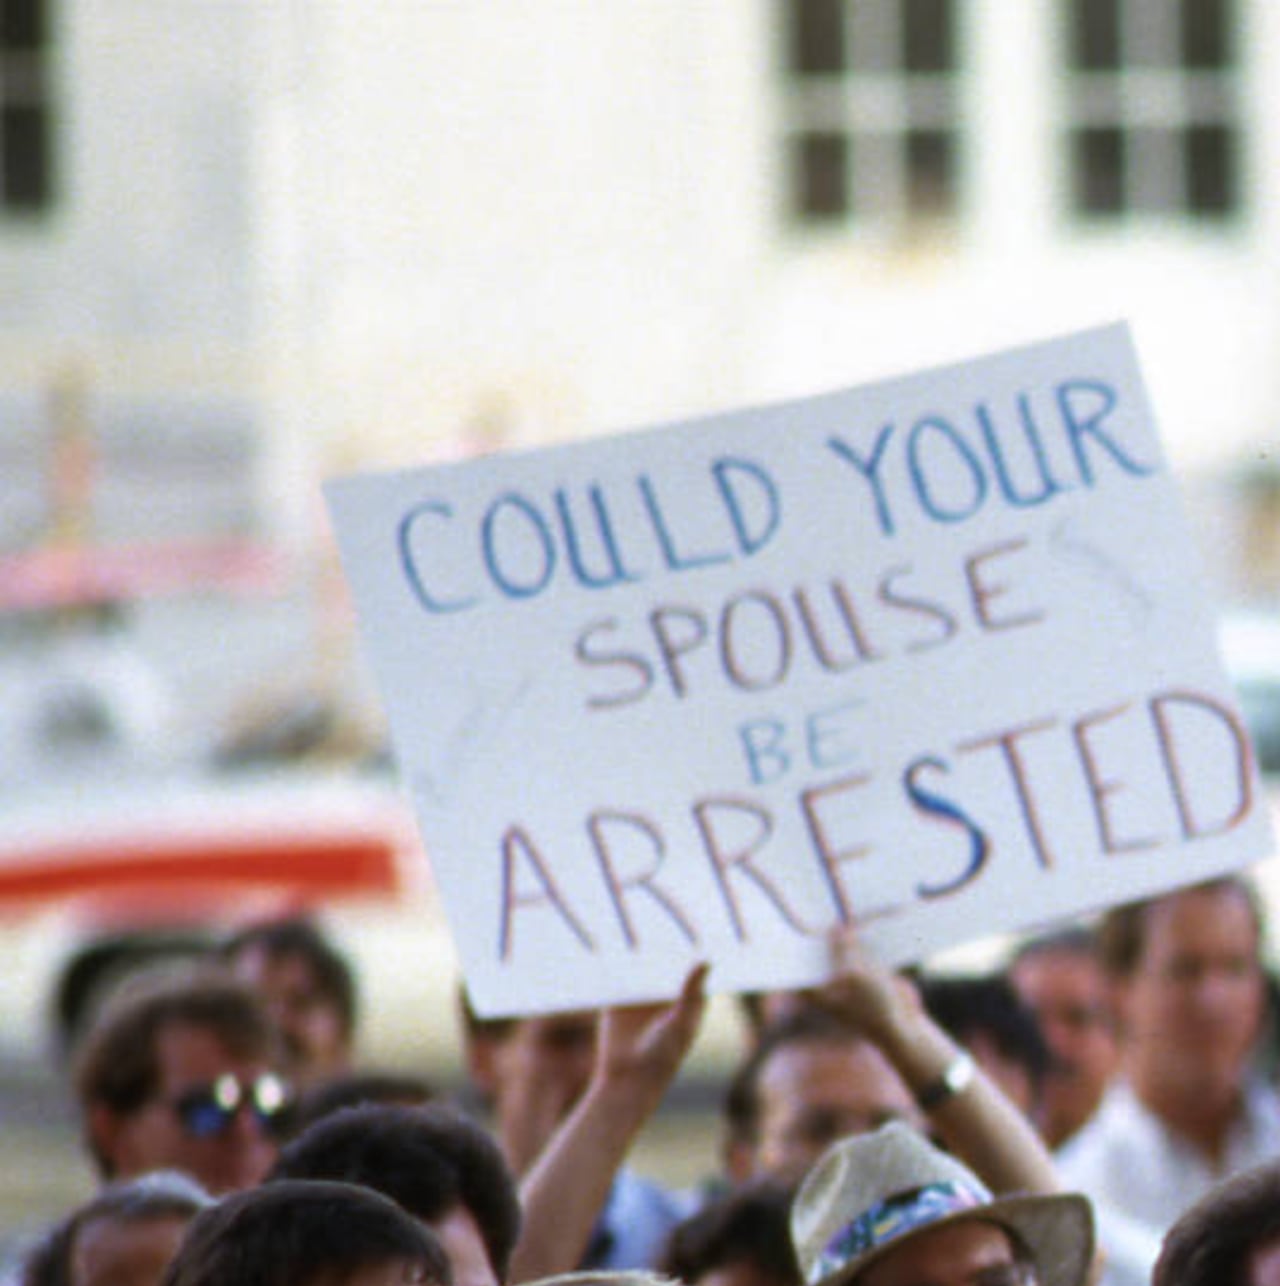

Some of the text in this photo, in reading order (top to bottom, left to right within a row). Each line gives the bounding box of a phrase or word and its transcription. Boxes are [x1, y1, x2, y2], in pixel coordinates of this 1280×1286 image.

[397, 378, 1156, 615] COULD YOUR
[573, 537, 1047, 711] SPOUSE
[497, 688, 1257, 962] ARRESTED
[737, 698, 868, 786] BE
